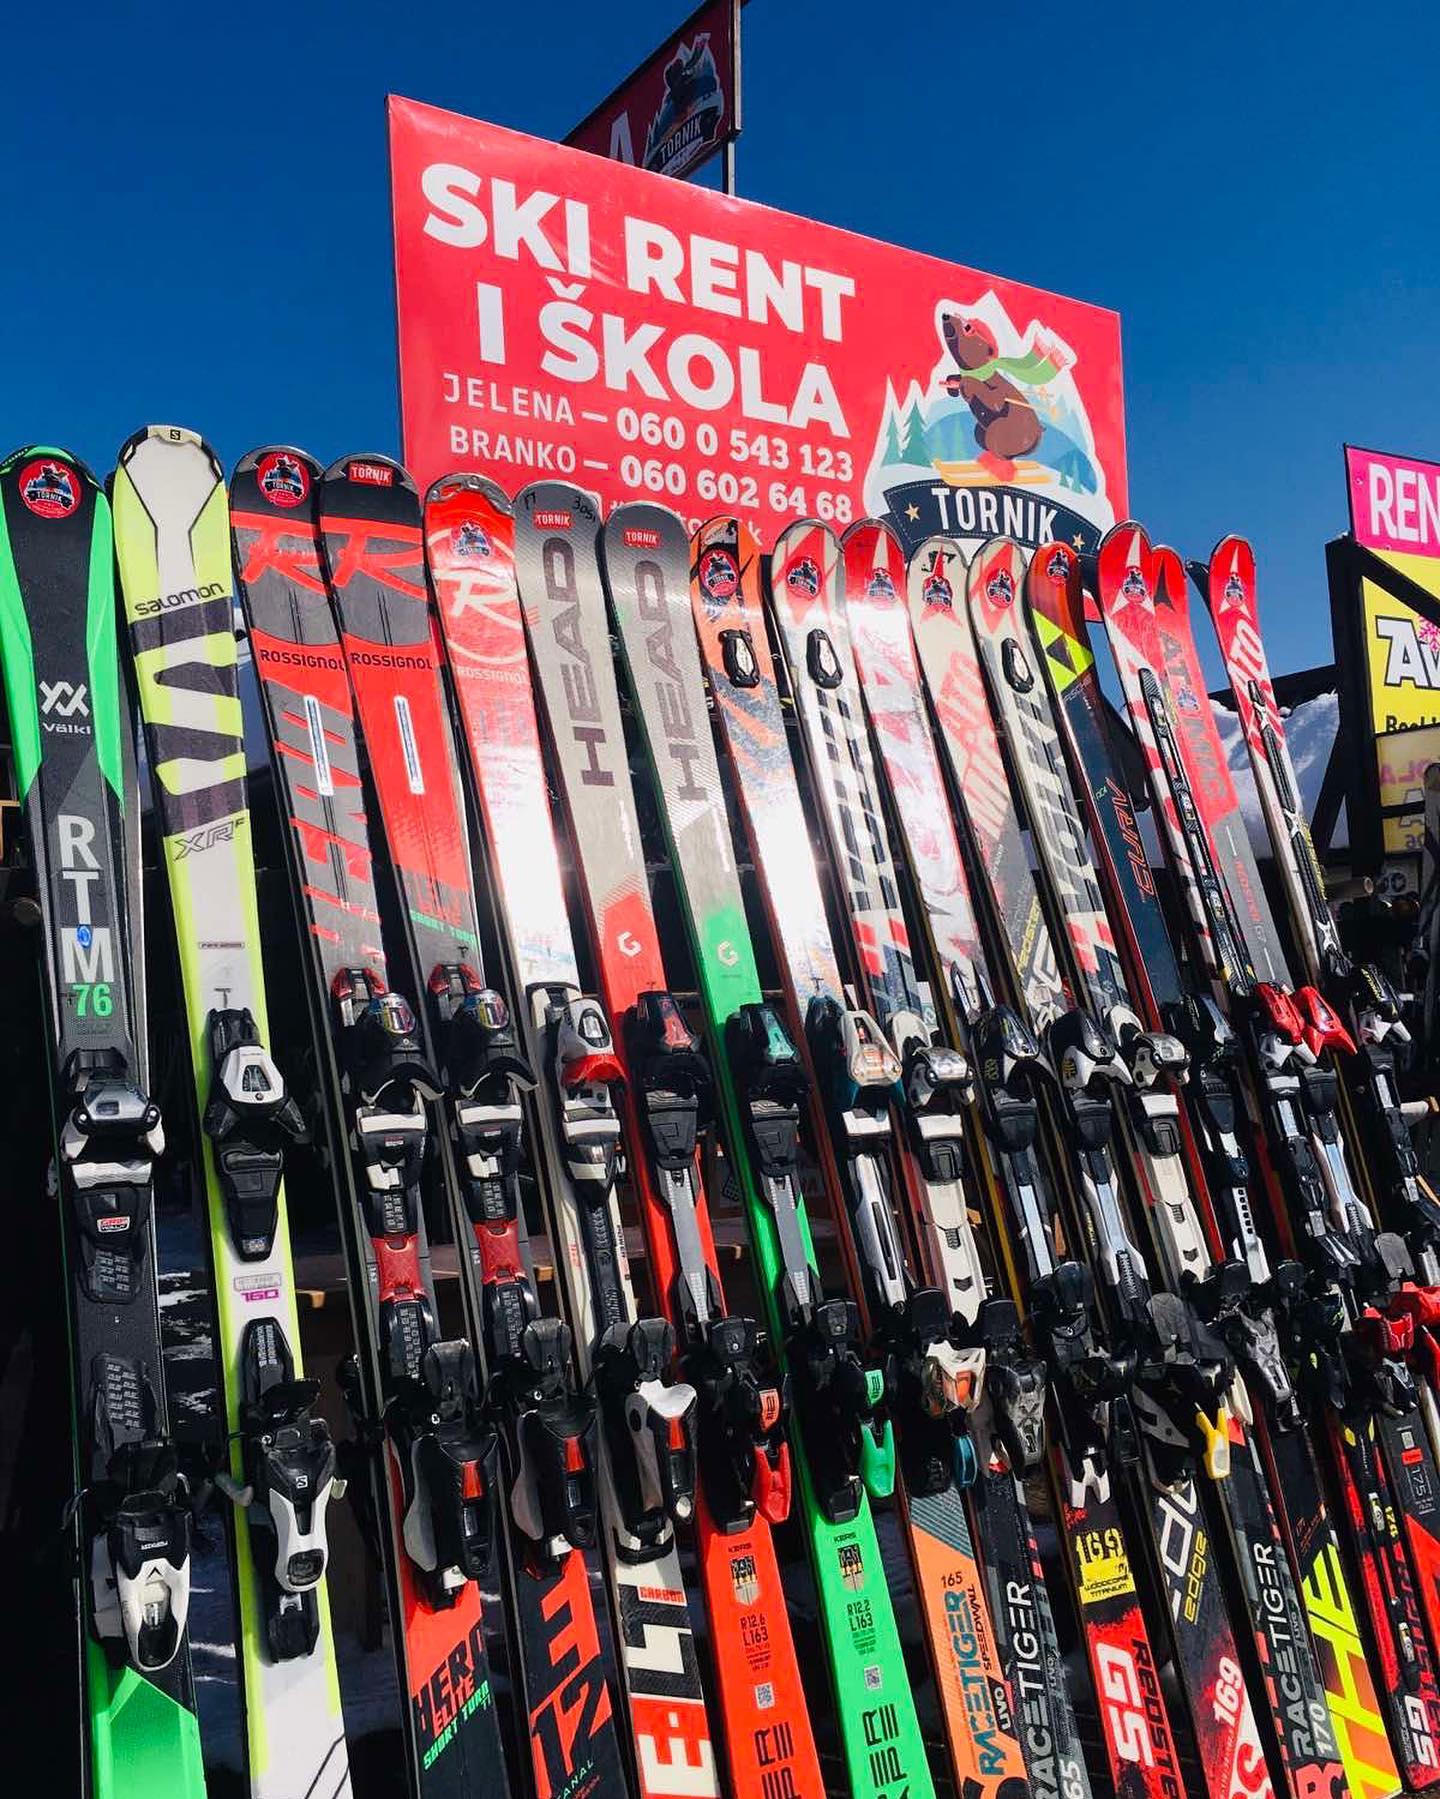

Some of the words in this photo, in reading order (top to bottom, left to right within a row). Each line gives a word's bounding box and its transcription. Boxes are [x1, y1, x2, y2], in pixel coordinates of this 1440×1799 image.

[420, 163, 593, 279] SKI
[624, 216, 856, 342] RENT
[476, 281, 506, 366] I
[538, 276, 852, 438] ŠKOLA
[443, 372, 577, 426] JELENA
[617, 406, 686, 450] 060
[695, 422, 719, 456] 0
[730, 430, 790, 470] 543
[799, 443, 855, 483] 123
[351, 465, 391, 483] TORNIK
[449, 424, 577, 474] BRANKO
[620, 454, 687, 496] 060
[696, 468, 761, 510] 602
[768, 479, 807, 518] 64
[814, 489, 854, 525] 68
[1368, 462, 1440, 543] REN
[535, 513, 571, 527] TORNIK
[625, 531, 658, 544] TORNIK
[931, 487, 1059, 545] TORNIK
[350, 652, 433, 670] ROSSIGNOL
[542, 536, 615, 787] HEAD
[634, 559, 708, 801] HEAD
[72, 983, 113, 1018] 76
[1412, 1465, 1427, 1496] 175
[940, 1571, 964, 1589] 165
[849, 1612, 874, 1632] L163
[1253, 1541, 1312, 1760] RACETIGER
[994, 1686, 1011, 1731] UVO
[1096, 1642, 1154, 1767] GS
[1213, 1656, 1243, 1727] 169
[1310, 1703, 1333, 1758] 170
[1403, 1696, 1439, 1767] GS
